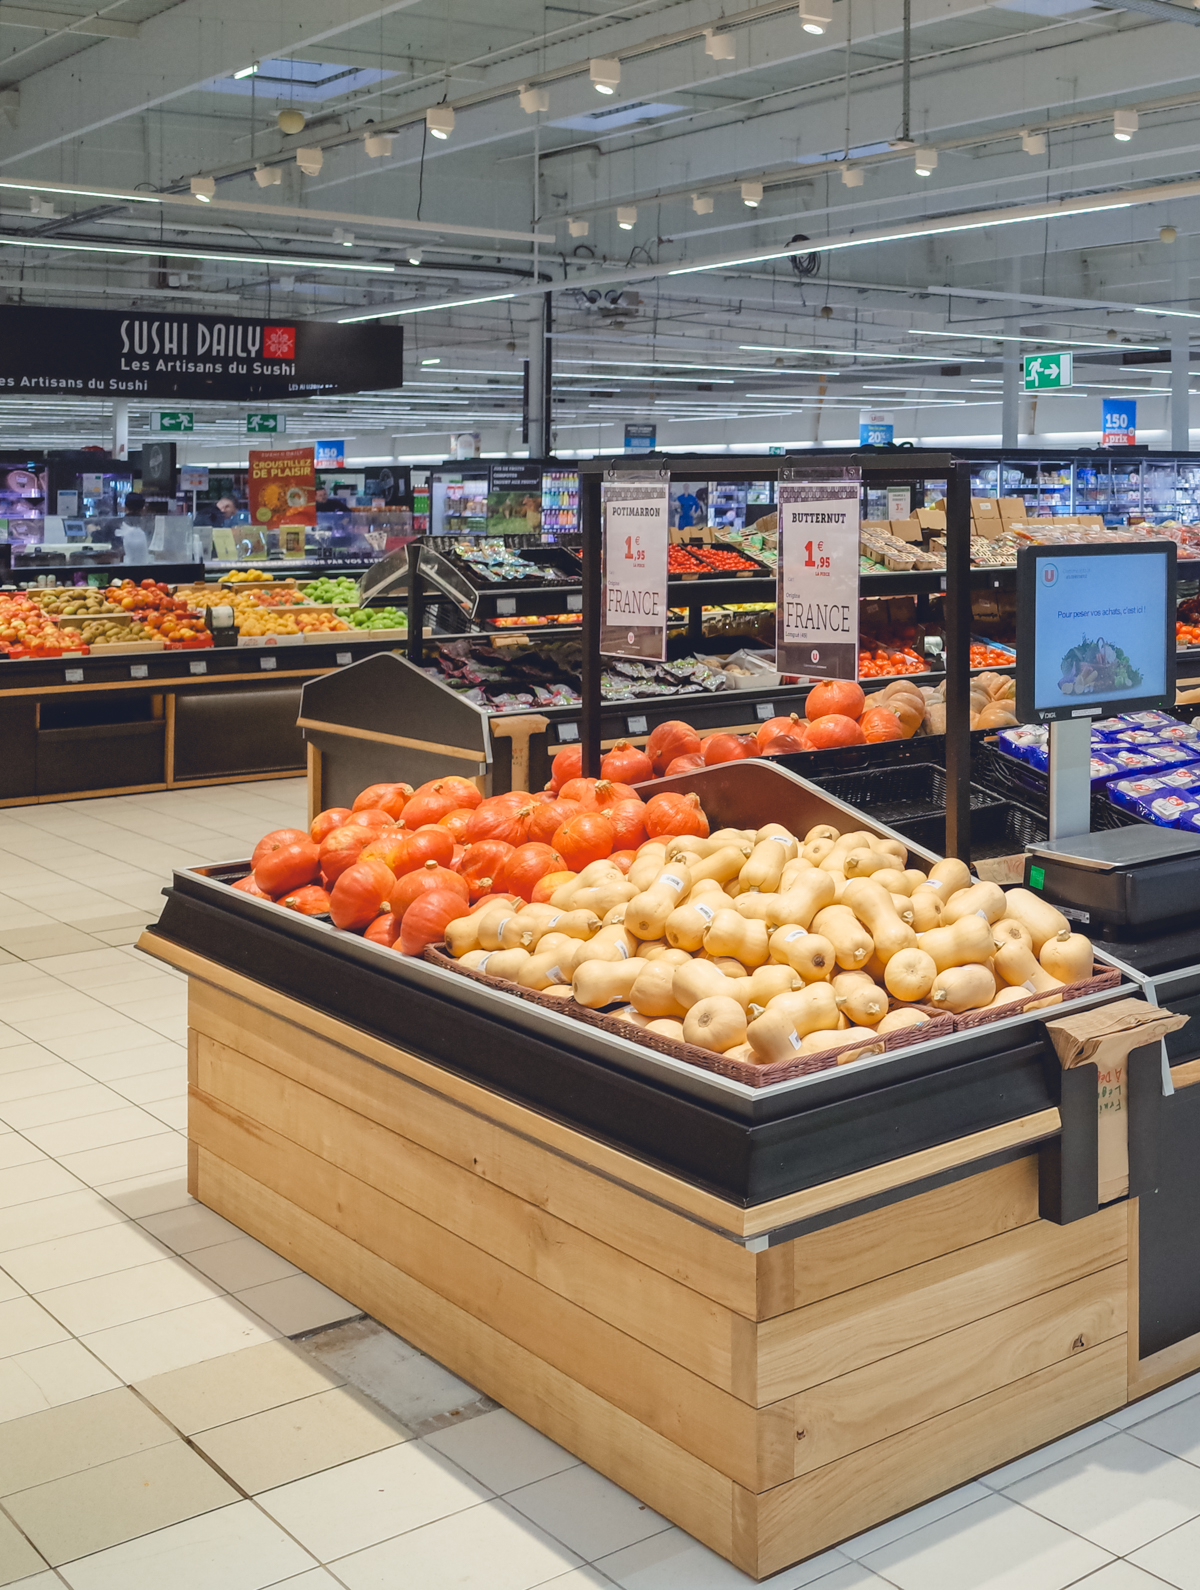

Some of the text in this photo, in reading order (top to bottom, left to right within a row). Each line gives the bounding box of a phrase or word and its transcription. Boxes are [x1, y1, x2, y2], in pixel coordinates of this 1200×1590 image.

[120, 320, 261, 358] SUSHI DAILY
[120, 357, 296, 376] Les Artisans du Sushi
[0, 376, 148, 391] es Artisans du Sushi
[1105, 413, 1128, 428] 150
[1109, 434, 1128, 444] prix
[318, 448, 337, 457] 150
[252, 459, 312, 469] CROUSTILLEZ
[252, 467, 311, 479] DE PLAISIR
[612, 506, 661, 517] POTIMARRON
[791, 512, 847, 524] BUTTERNUT
[1044, 569, 1055, 583] U
[608, 588, 659, 616] FRANCE
[786, 601, 850, 633] FRANCE
[1057, 610, 1072, 619] Pour
[1098, 1085, 1121, 1098] Lég
[1099, 1099, 1121, 1114] Frui
